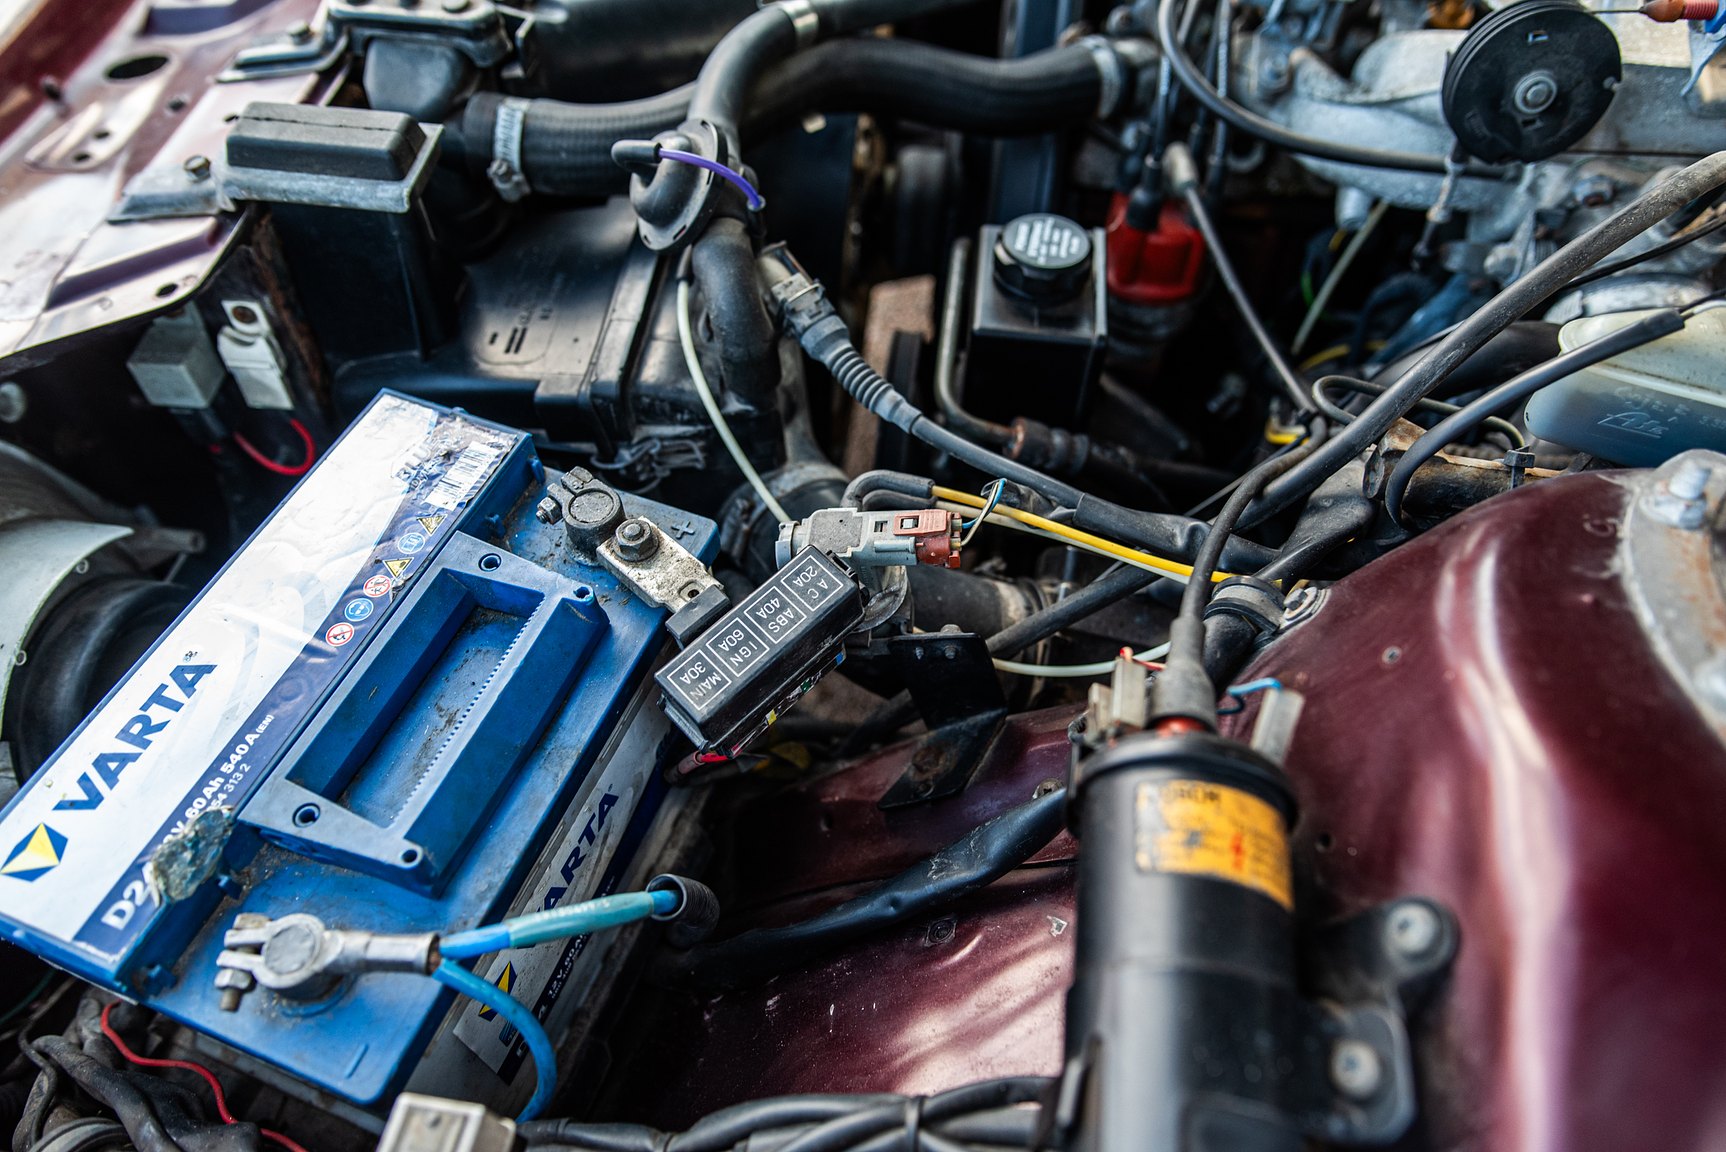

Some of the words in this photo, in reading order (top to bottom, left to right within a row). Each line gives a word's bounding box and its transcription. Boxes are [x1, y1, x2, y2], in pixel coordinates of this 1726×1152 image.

[792, 565, 818, 587] 20A
[755, 597, 781, 619] 40A
[768, 608, 795, 633] ABS
[717, 629, 745, 651] 60A
[679, 661, 706, 684] 30A
[689, 672, 722, 700] MAIN
[51, 663, 219, 811] VARTA
[223, 772, 244, 792] 313
[240, 763, 252, 773] 2
[184, 777, 226, 819] 60Ah
